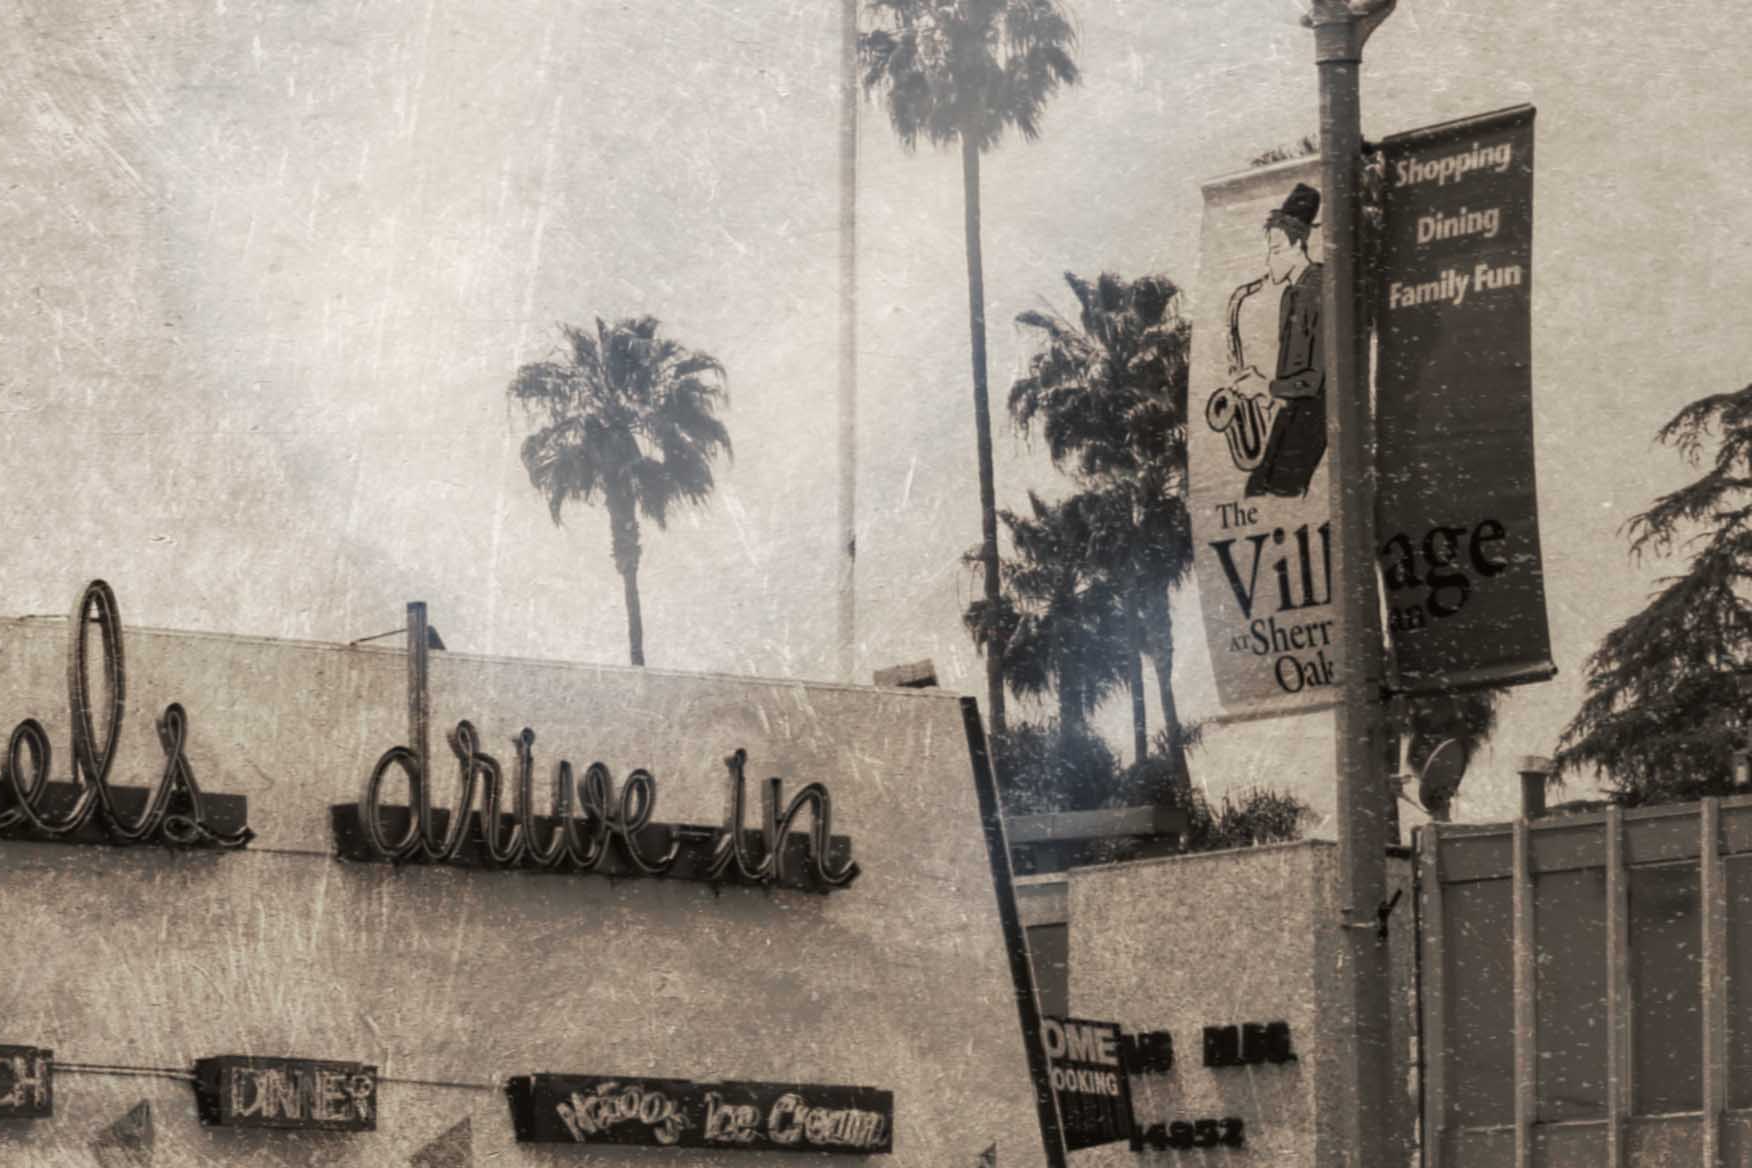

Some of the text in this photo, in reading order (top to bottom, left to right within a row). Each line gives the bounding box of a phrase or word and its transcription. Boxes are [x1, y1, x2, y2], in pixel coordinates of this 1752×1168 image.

[1395, 141, 1512, 187] Shopping
[1417, 205, 1500, 245] Dining
[1389, 263, 1521, 310] Family Fun
[1216, 502, 1258, 530] The
[1229, 634, 1249, 653] AT
[359, 602, 860, 888] drive-in
[230, 1065, 373, 1122] DINNER
[704, 1091, 762, 1144] Ice
[768, 1092, 890, 1148] Cream
